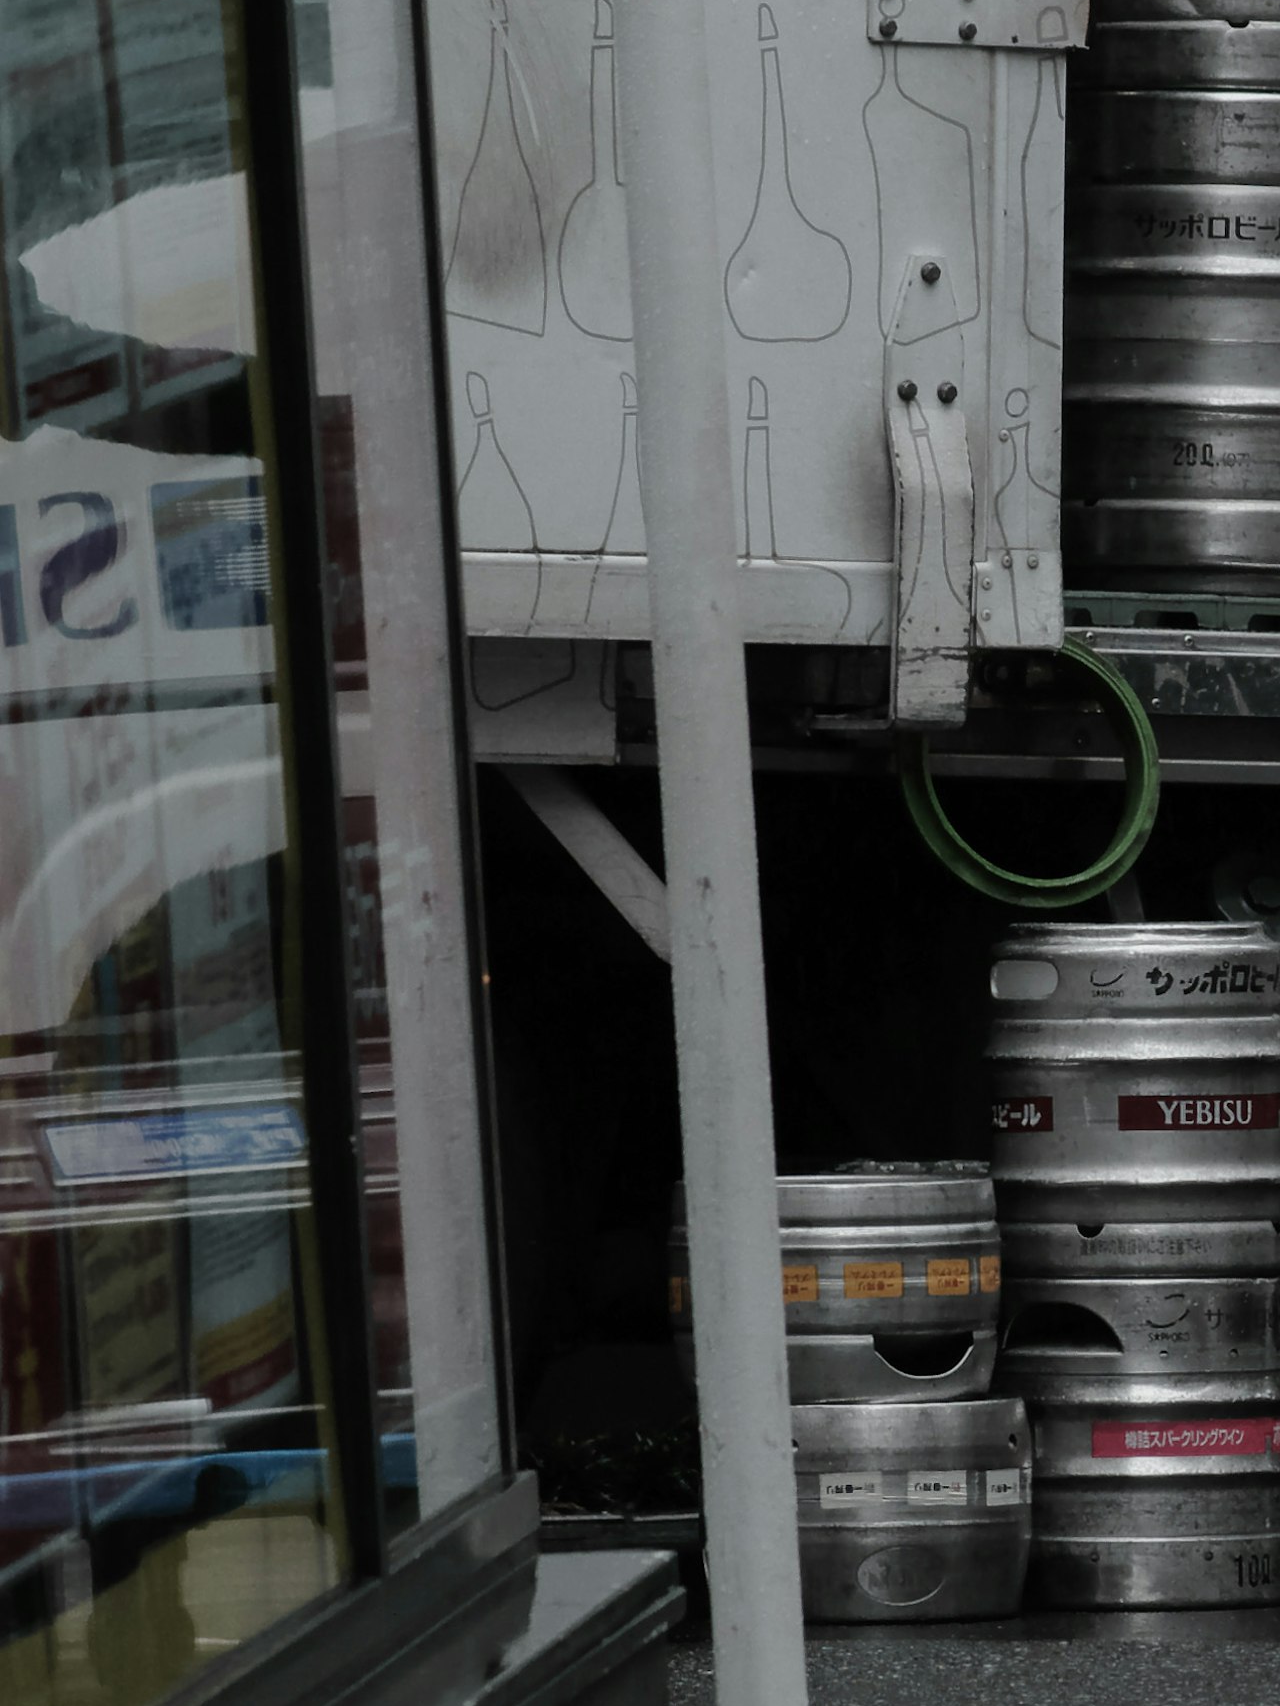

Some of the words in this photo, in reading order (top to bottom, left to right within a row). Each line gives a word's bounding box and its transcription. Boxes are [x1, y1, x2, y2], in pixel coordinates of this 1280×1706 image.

[1157, 1100, 1253, 1125] YEBISU
[1124, 1430, 1244, 1450] 樽詰スパークリングワイン
